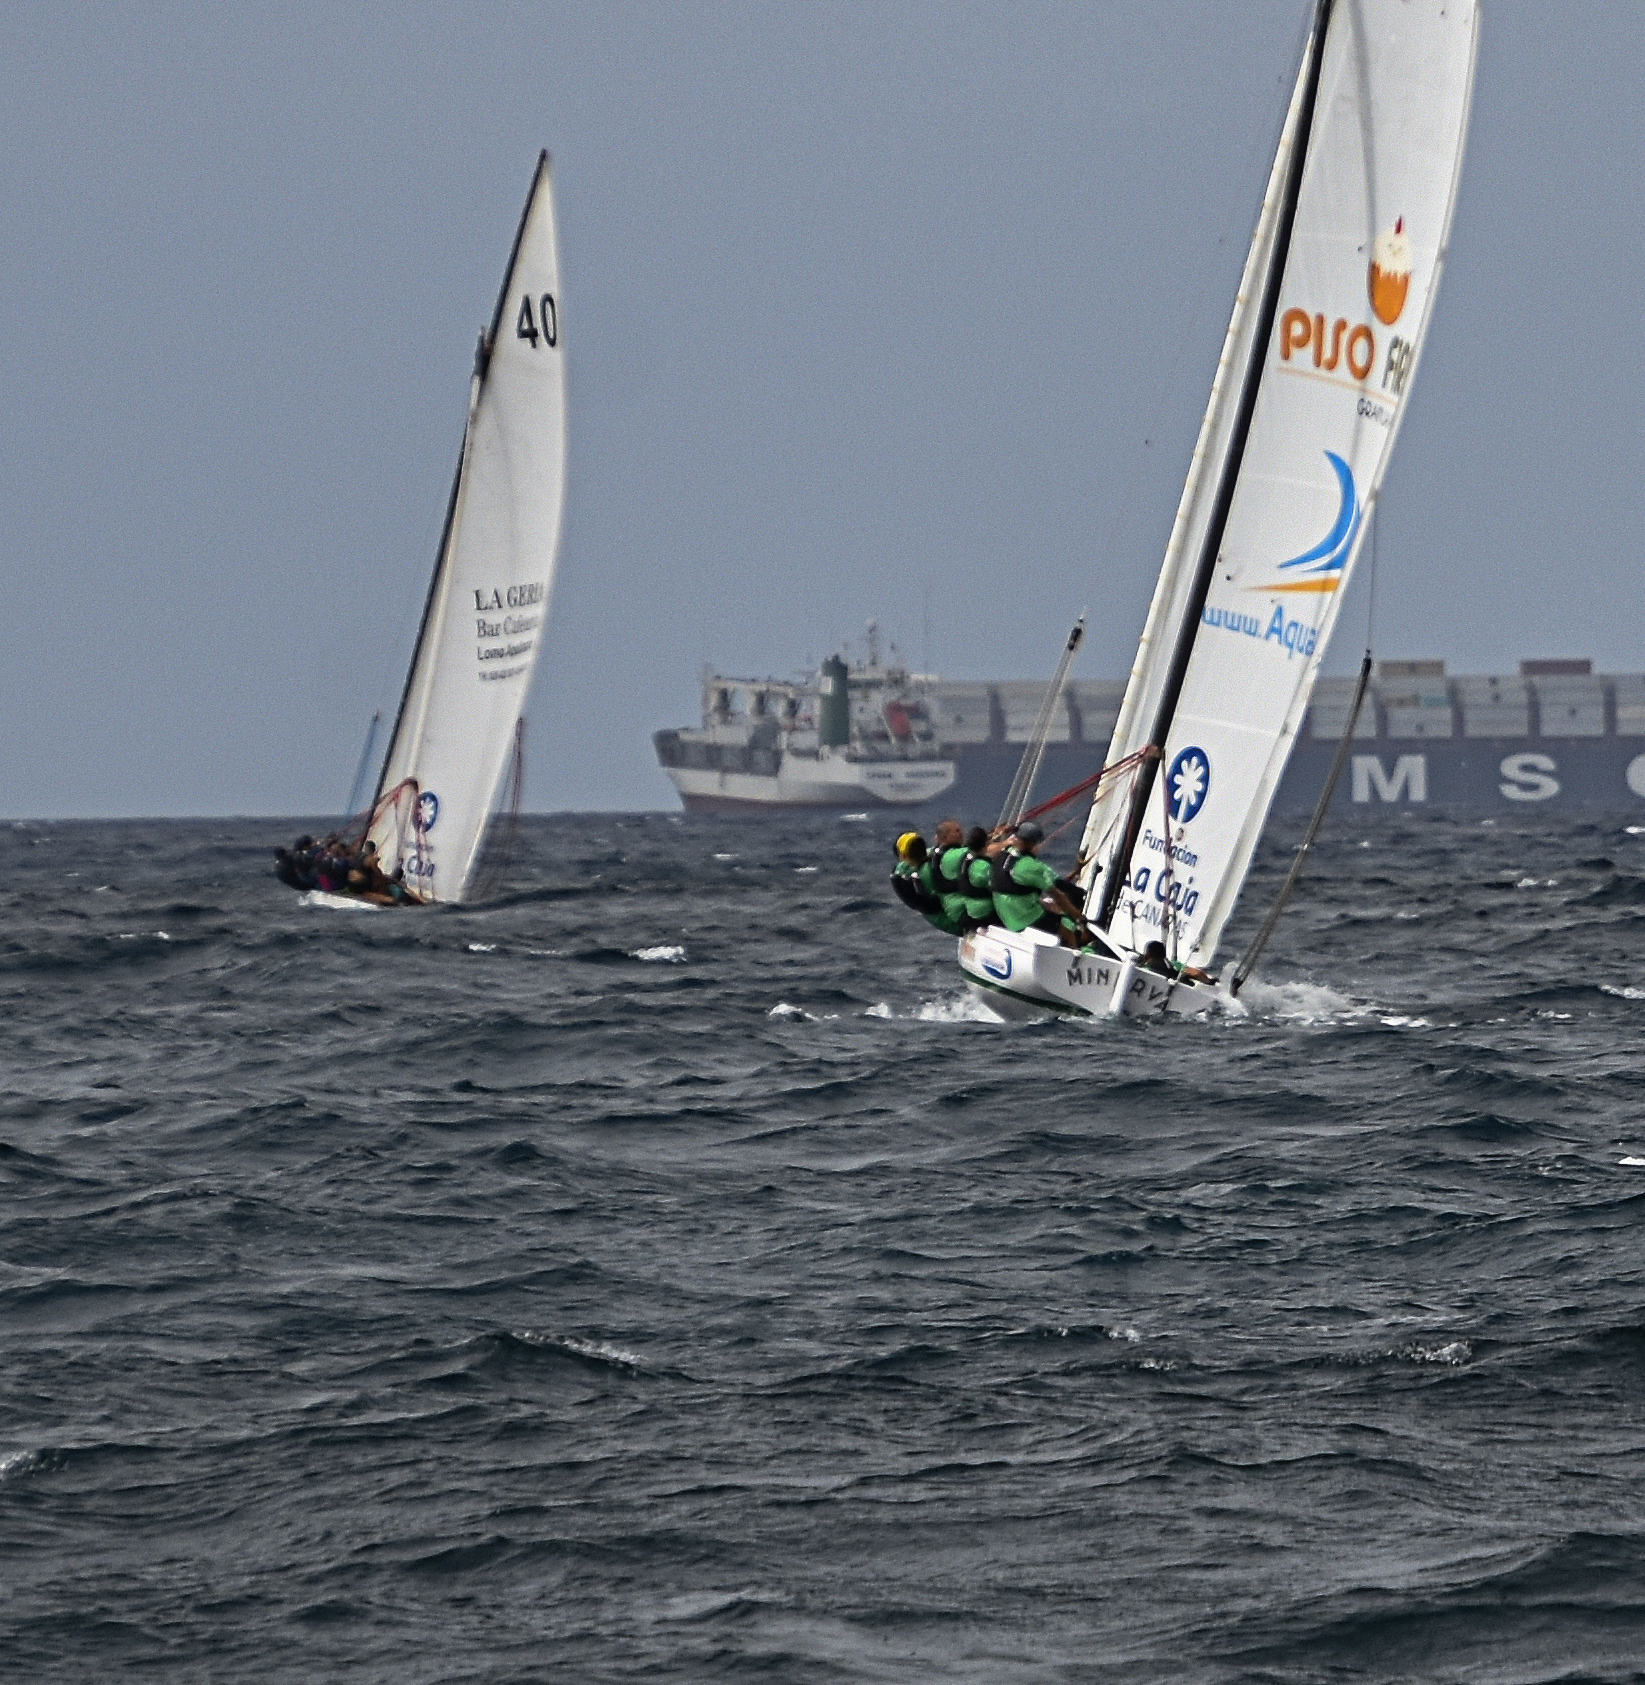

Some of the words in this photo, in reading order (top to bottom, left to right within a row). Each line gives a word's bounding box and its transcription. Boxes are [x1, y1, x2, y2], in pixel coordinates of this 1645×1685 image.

[516, 292, 557, 349] 40
[1279, 306, 1375, 381] PISO
[475, 589, 503, 611] LA
[477, 618, 500, 637] Bar
[1066, 967, 1172, 1013] MINRVA
